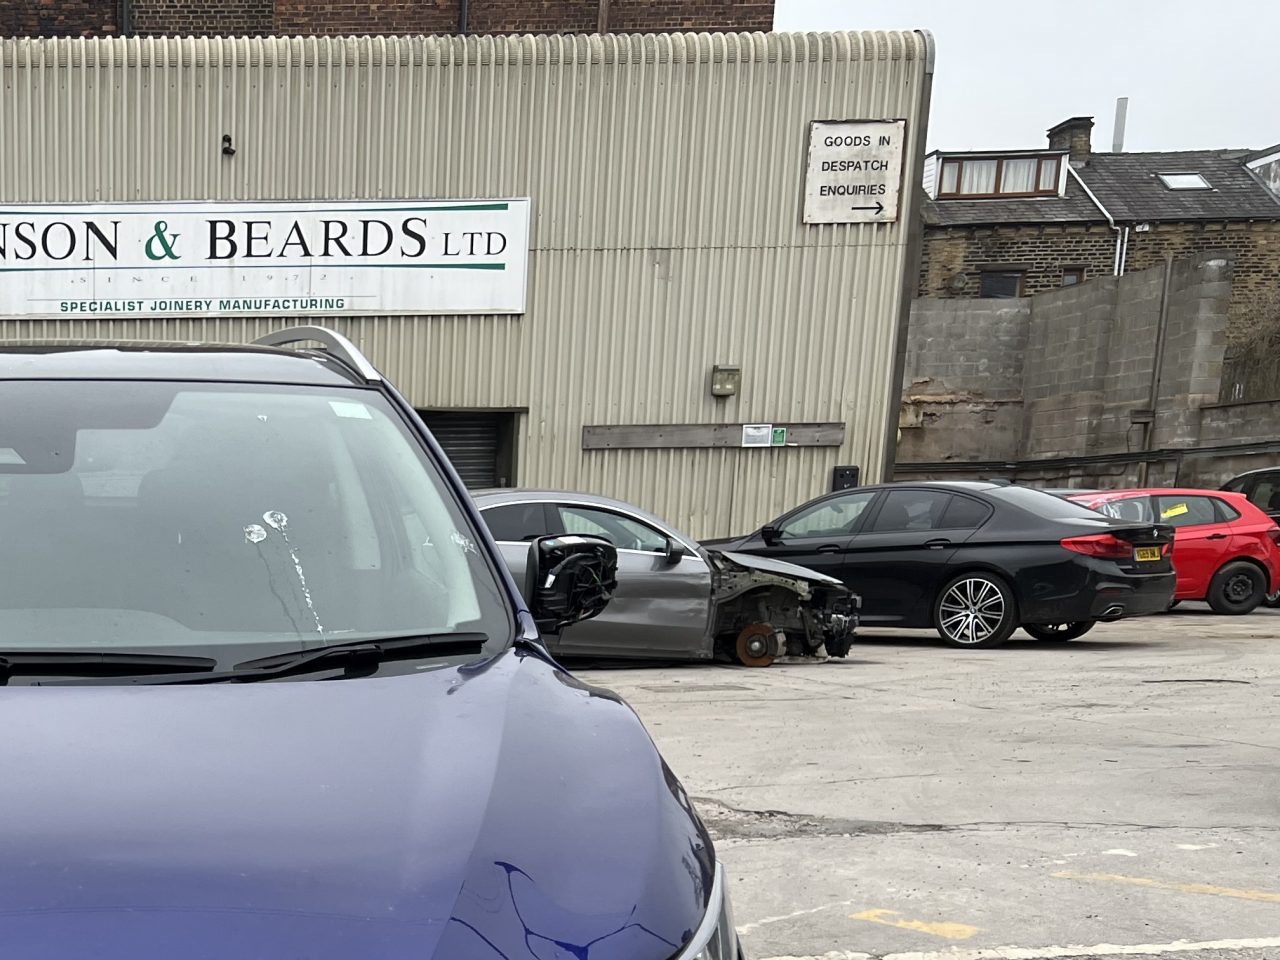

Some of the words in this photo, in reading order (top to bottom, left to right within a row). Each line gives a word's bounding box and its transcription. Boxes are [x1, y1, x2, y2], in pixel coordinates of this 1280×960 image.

[824, 135, 871, 147] GOODS
[878, 135, 891, 146] IN
[821, 160, 889, 172] DESPATCH
[819, 184, 886, 197] ENQUIRIES
[144, 219, 182, 261] &
[205, 217, 427, 260] BEARDS
[441, 232, 507, 256] LTD
[60, 301, 144, 312] SPECIALIST
[150, 300, 213, 312] JOINERY
[219, 299, 345, 311] MANUFACTURING
